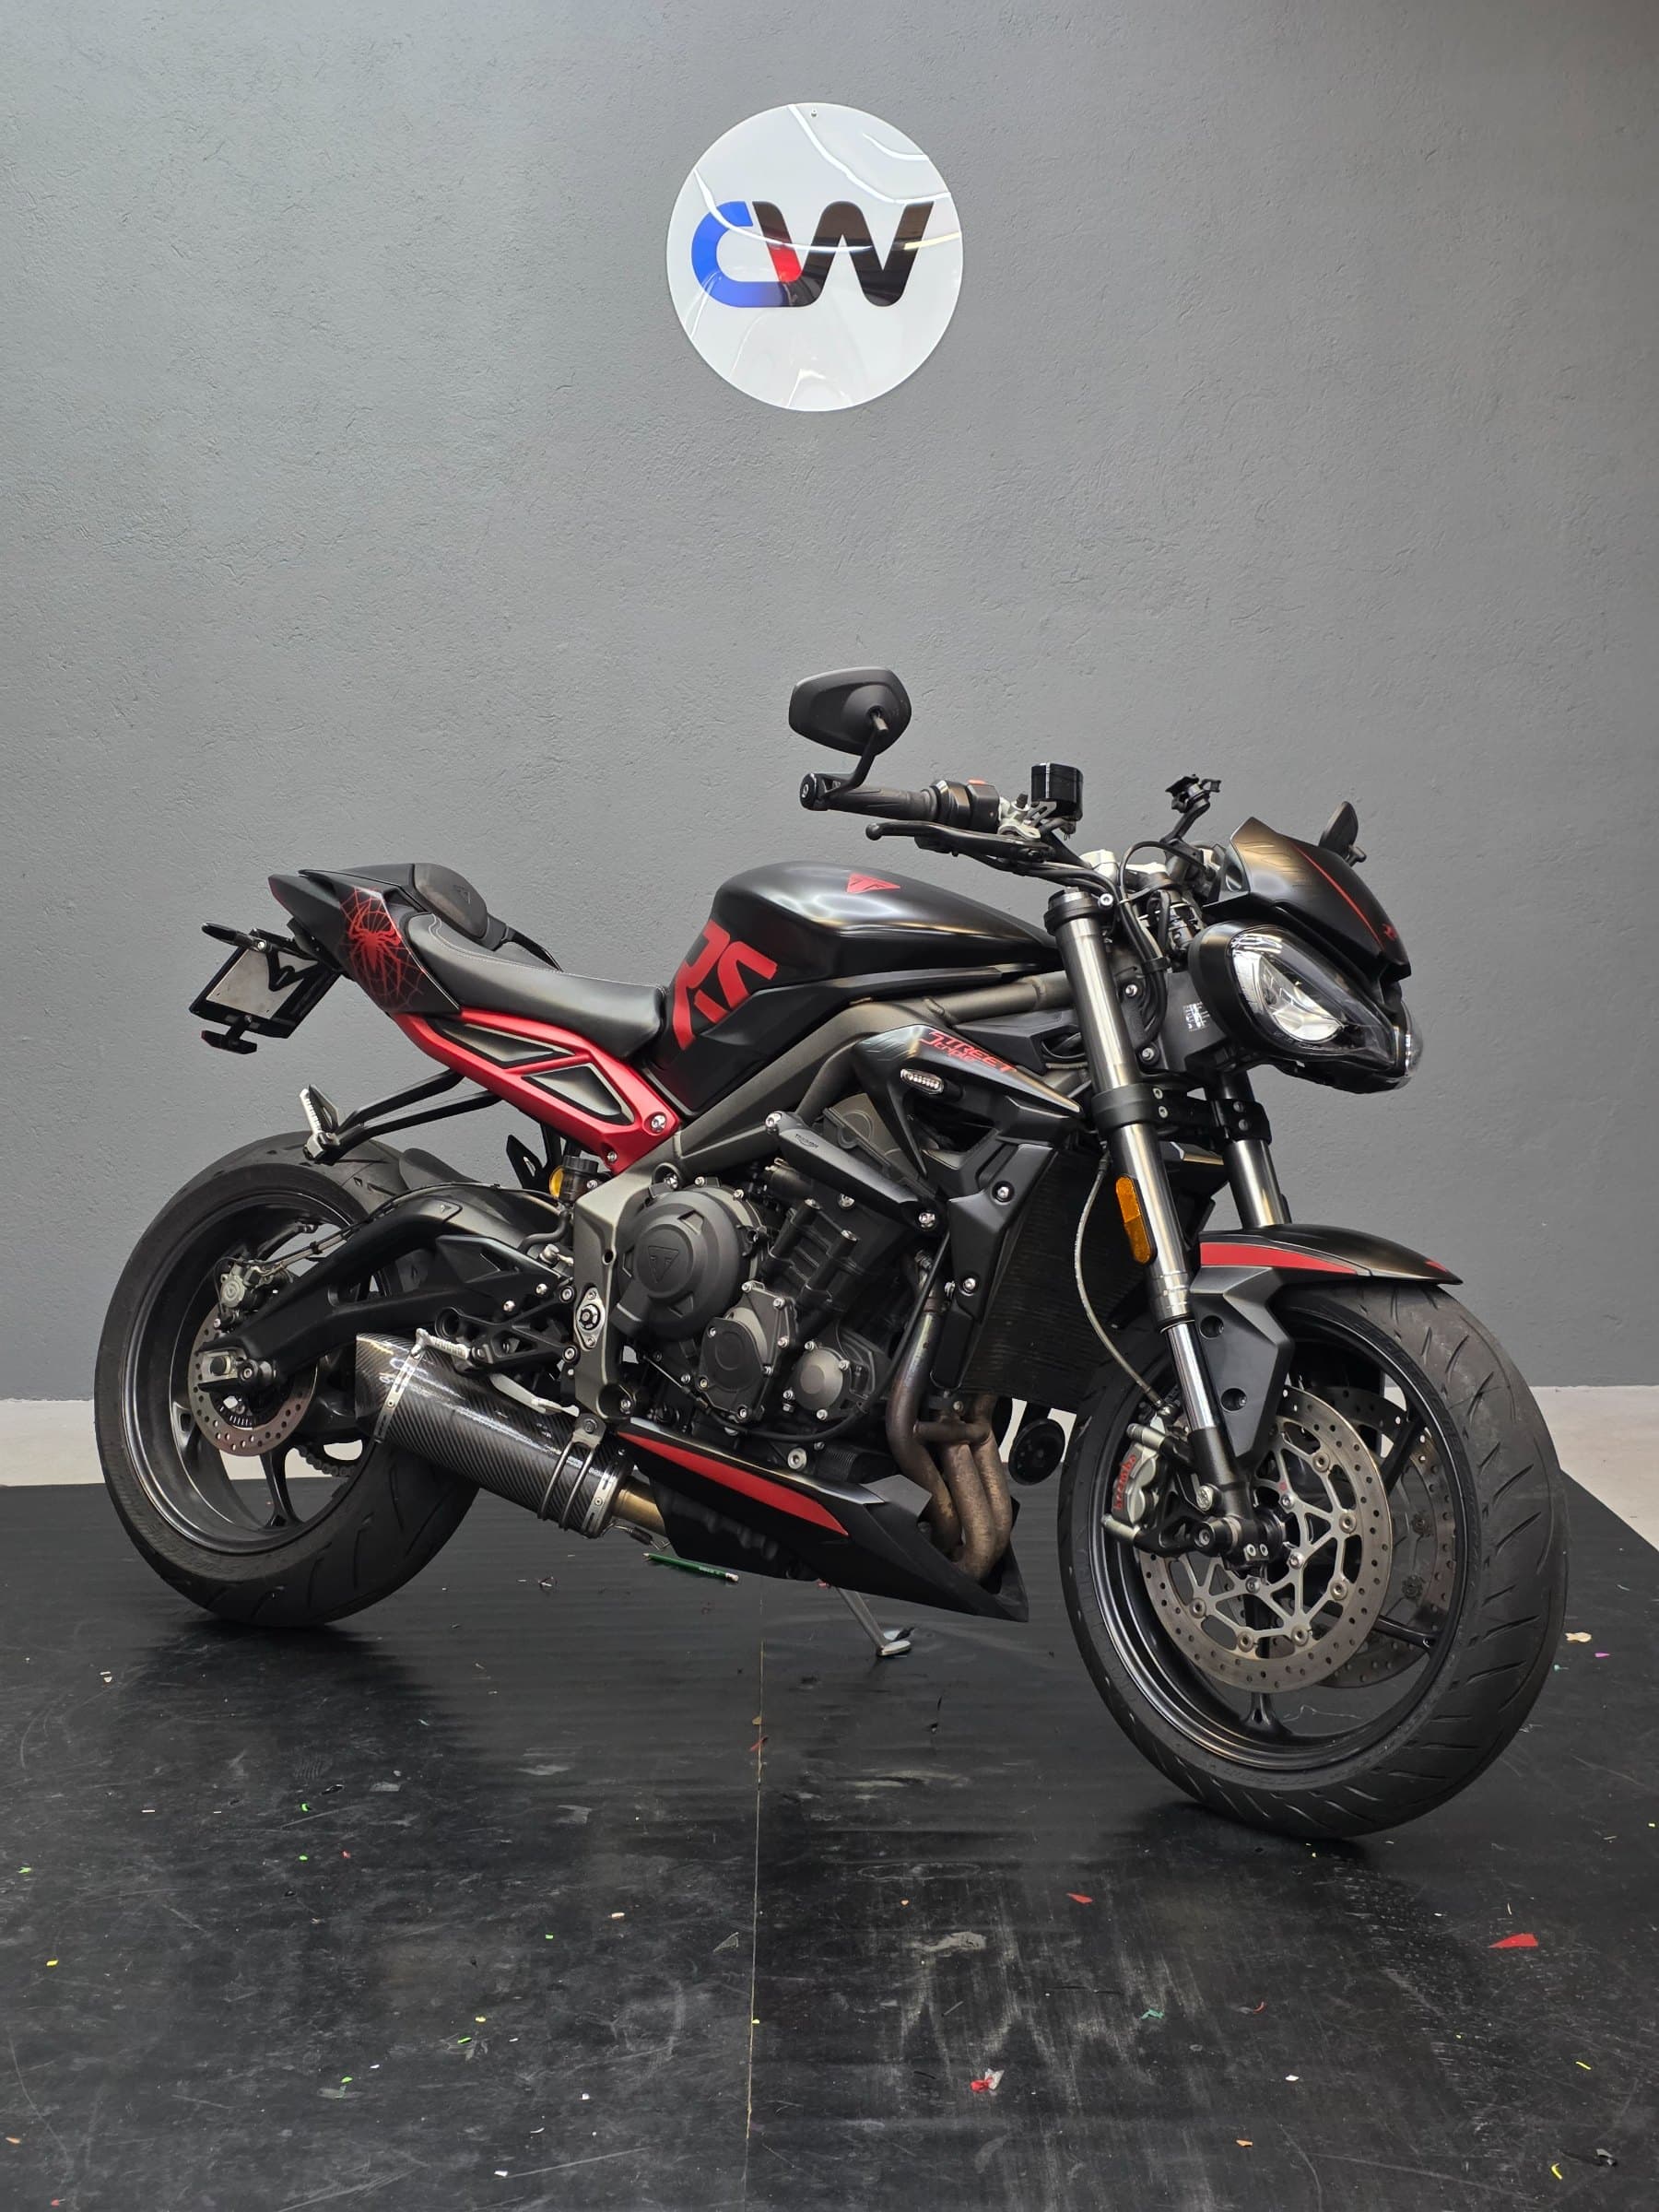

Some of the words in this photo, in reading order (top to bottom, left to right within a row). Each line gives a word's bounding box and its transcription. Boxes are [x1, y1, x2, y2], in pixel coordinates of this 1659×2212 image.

[691, 200, 935, 308] CW
[672, 919, 777, 1050] RS
[918, 1030, 1018, 1074] STREET
